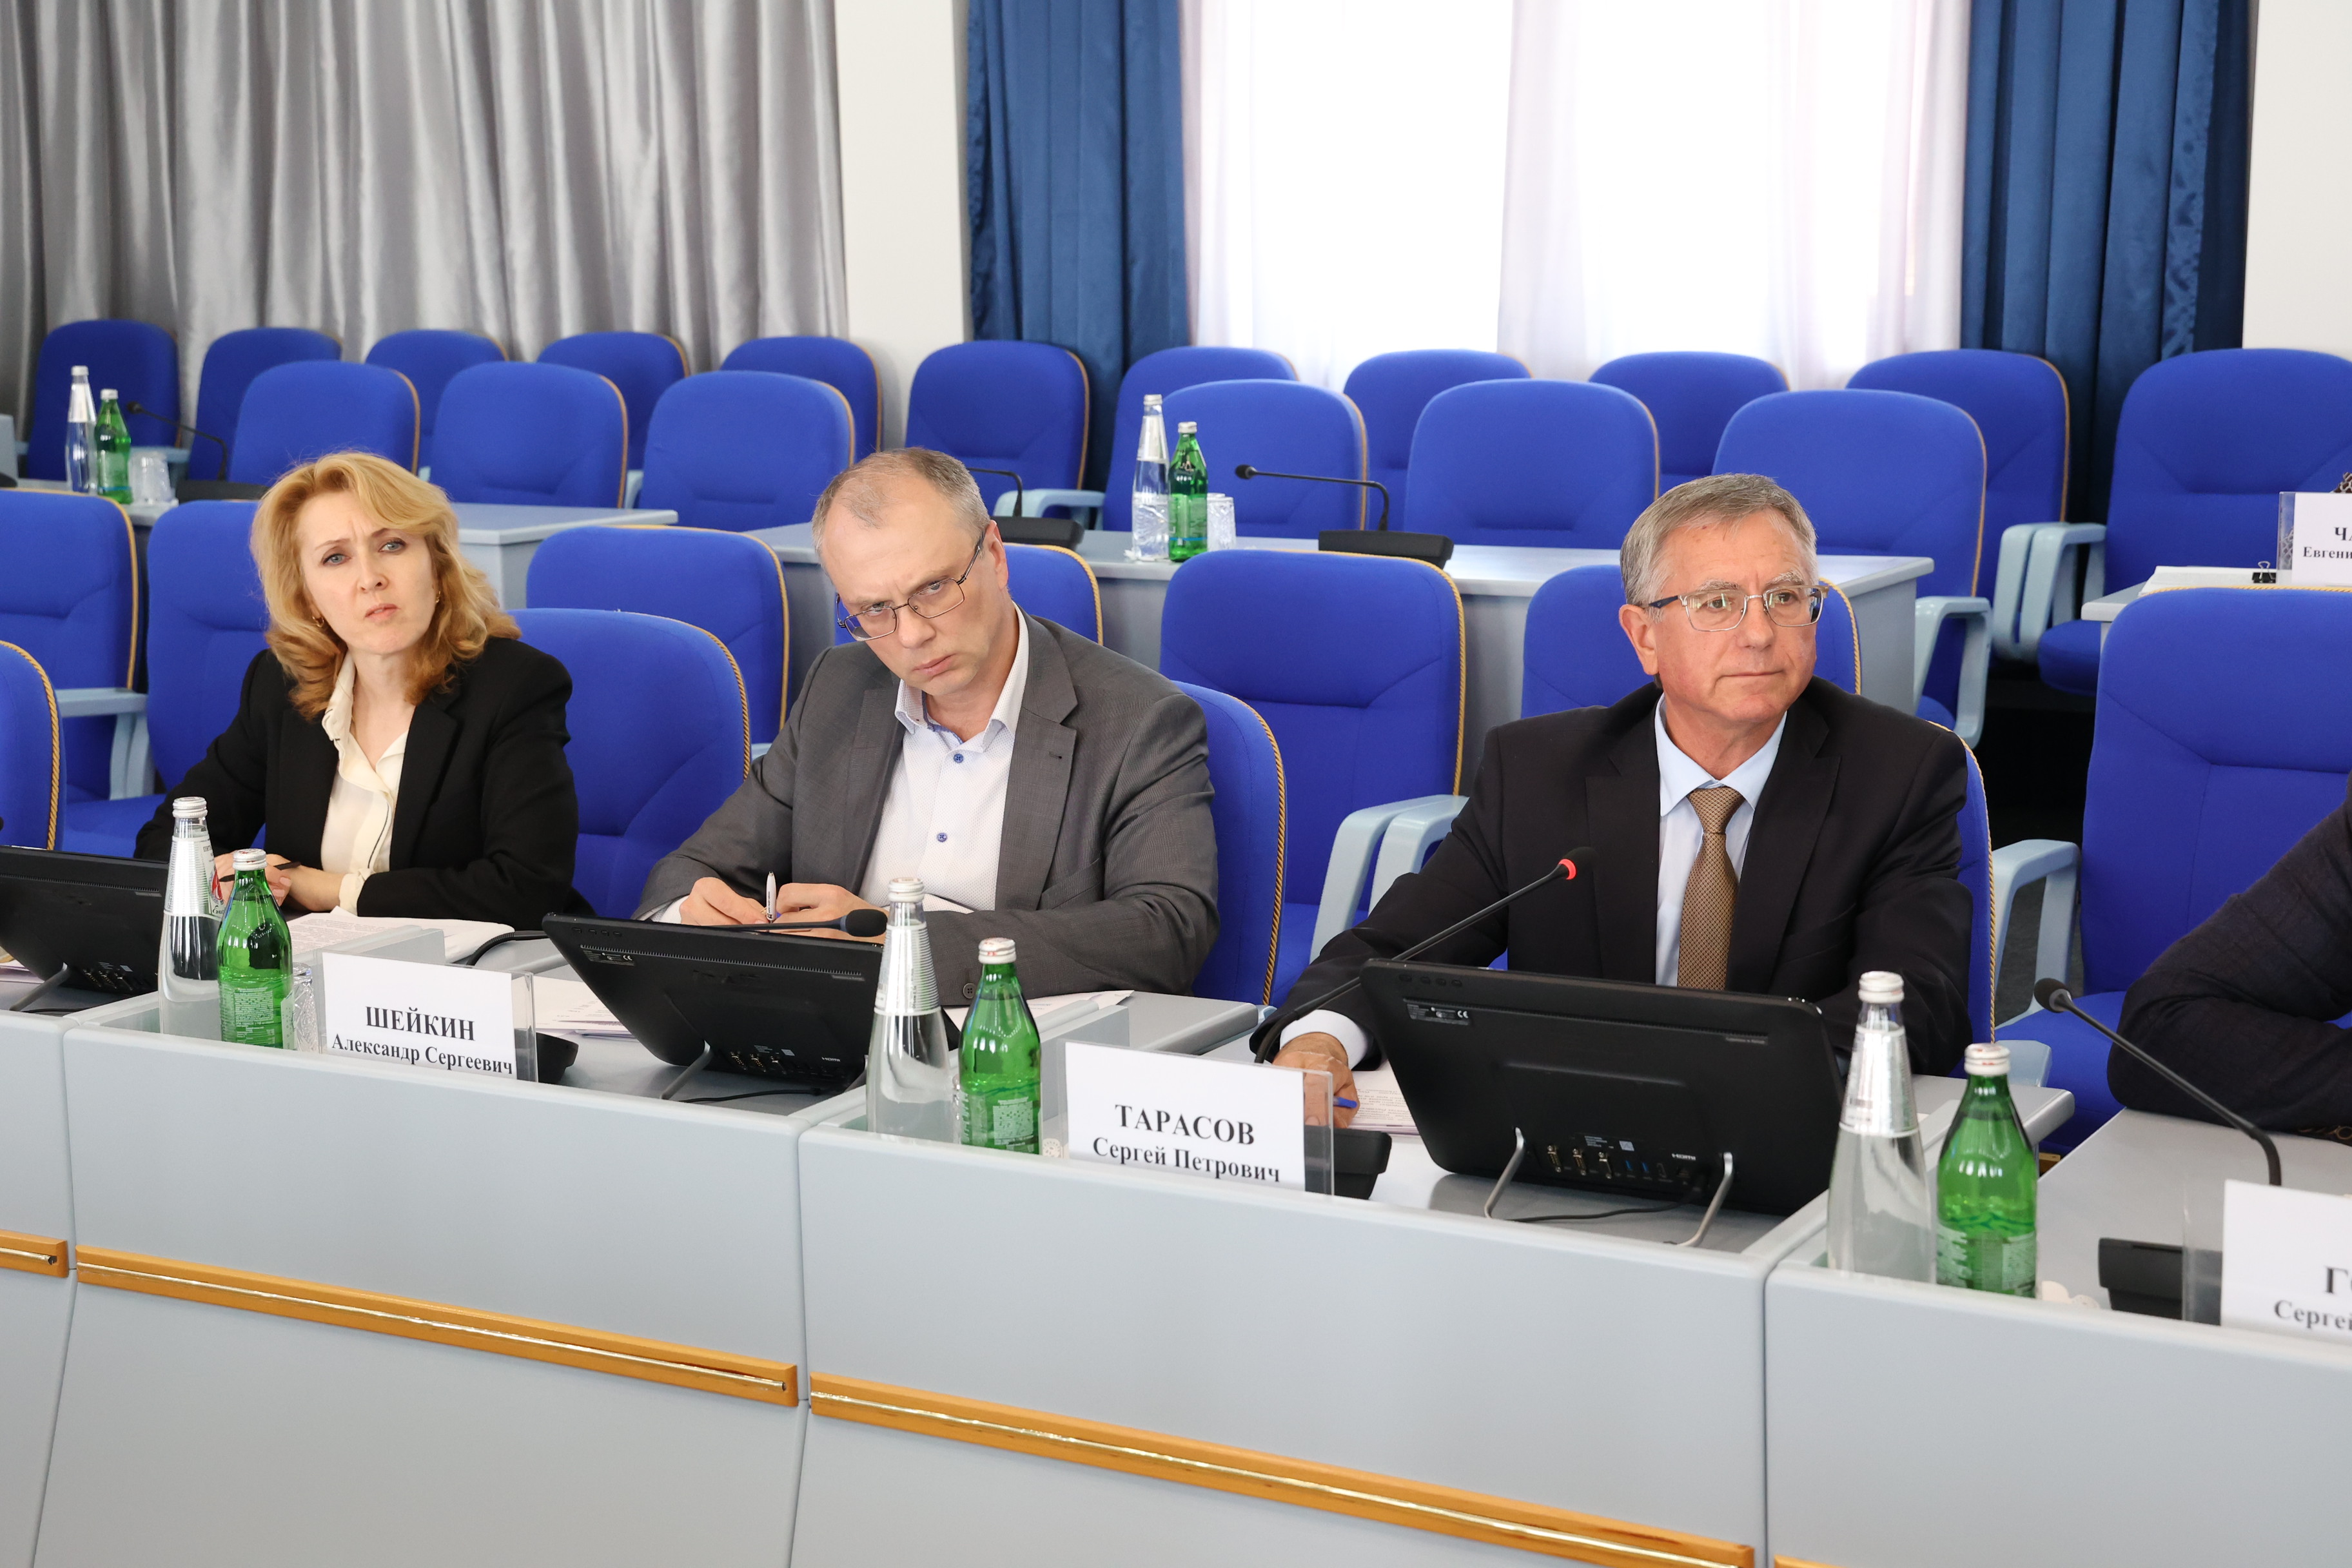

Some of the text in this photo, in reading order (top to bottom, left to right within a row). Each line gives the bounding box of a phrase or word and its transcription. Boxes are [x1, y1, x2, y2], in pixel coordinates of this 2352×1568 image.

[2334, 527, 2352, 541] Ч
[365, 1006, 475, 1041] ШЕЙКИН
[331, 1034, 513, 1074] Александр Сергеевич
[1115, 1104, 1255, 1145] ТАРАСОВ
[1093, 1137, 1280, 1182] Сергей Петрович
[2324, 1266, 2352, 1295] Г
